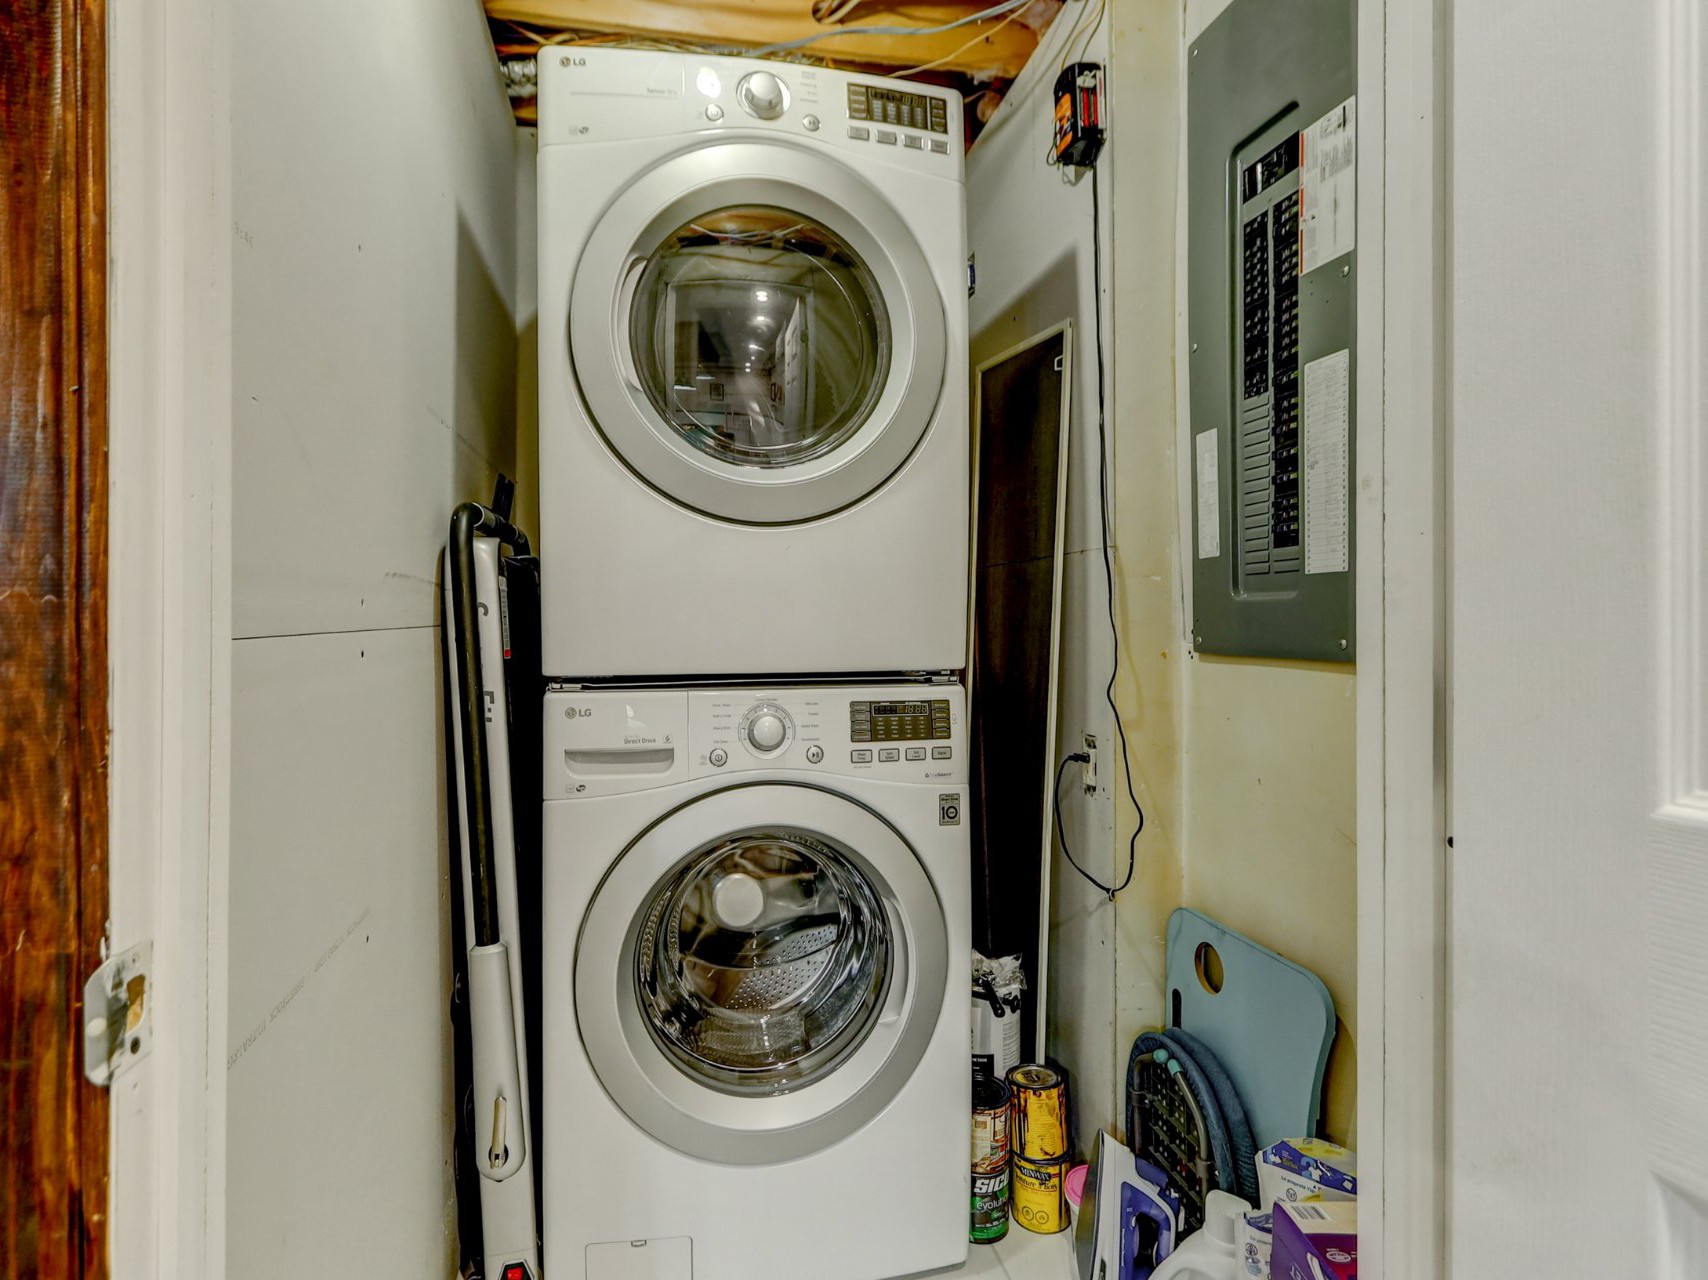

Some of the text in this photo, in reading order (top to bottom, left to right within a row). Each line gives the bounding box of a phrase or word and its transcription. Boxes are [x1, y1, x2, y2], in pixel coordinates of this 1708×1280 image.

[573, 58, 586, 66] LG
[579, 708, 592, 717] LG
[941, 805, 958, 820] 10
[1020, 1166, 1050, 1181] MINWAX
